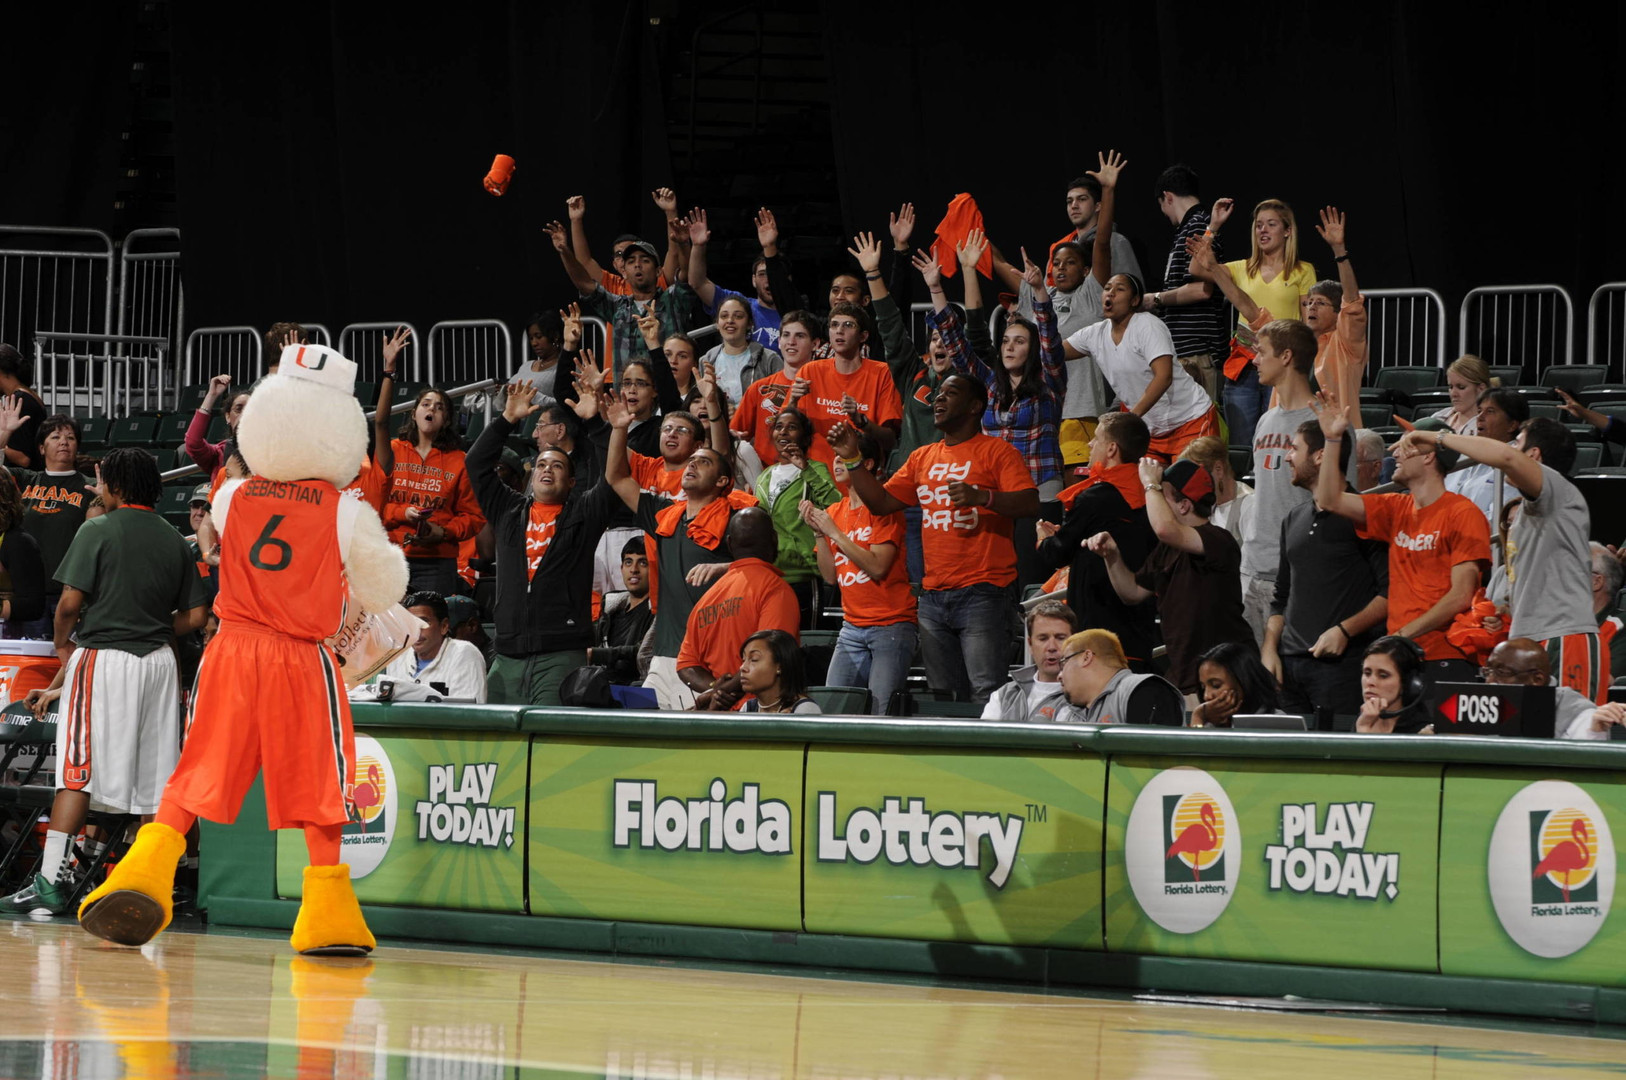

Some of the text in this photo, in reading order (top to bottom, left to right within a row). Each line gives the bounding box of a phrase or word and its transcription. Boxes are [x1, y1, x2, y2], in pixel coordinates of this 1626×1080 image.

[1254, 433, 1294, 452] MIAM
[394, 462, 455, 482] NIVERSITY OF
[928, 461, 971, 481] AY
[21, 484, 83, 508] MIAMI
[245, 479, 323, 505] SEBASTIAN
[917, 484, 979, 507] BA
[922, 507, 979, 531] BAY
[249, 514, 292, 571] 6
[698, 597, 744, 629] EVENT STAFF
[1458, 695, 1499, 724] POSS
[428, 763, 498, 804] PLAY
[416, 801, 516, 848] TODAY!
[613, 777, 793, 855] Florida
[816, 791, 1025, 891] Lottery
[1282, 802, 1375, 850] PLAY
[1264, 844, 1400, 901] TODAY!
[1164, 884, 1194, 895] Florida
[1531, 905, 1562, 917] Florida
